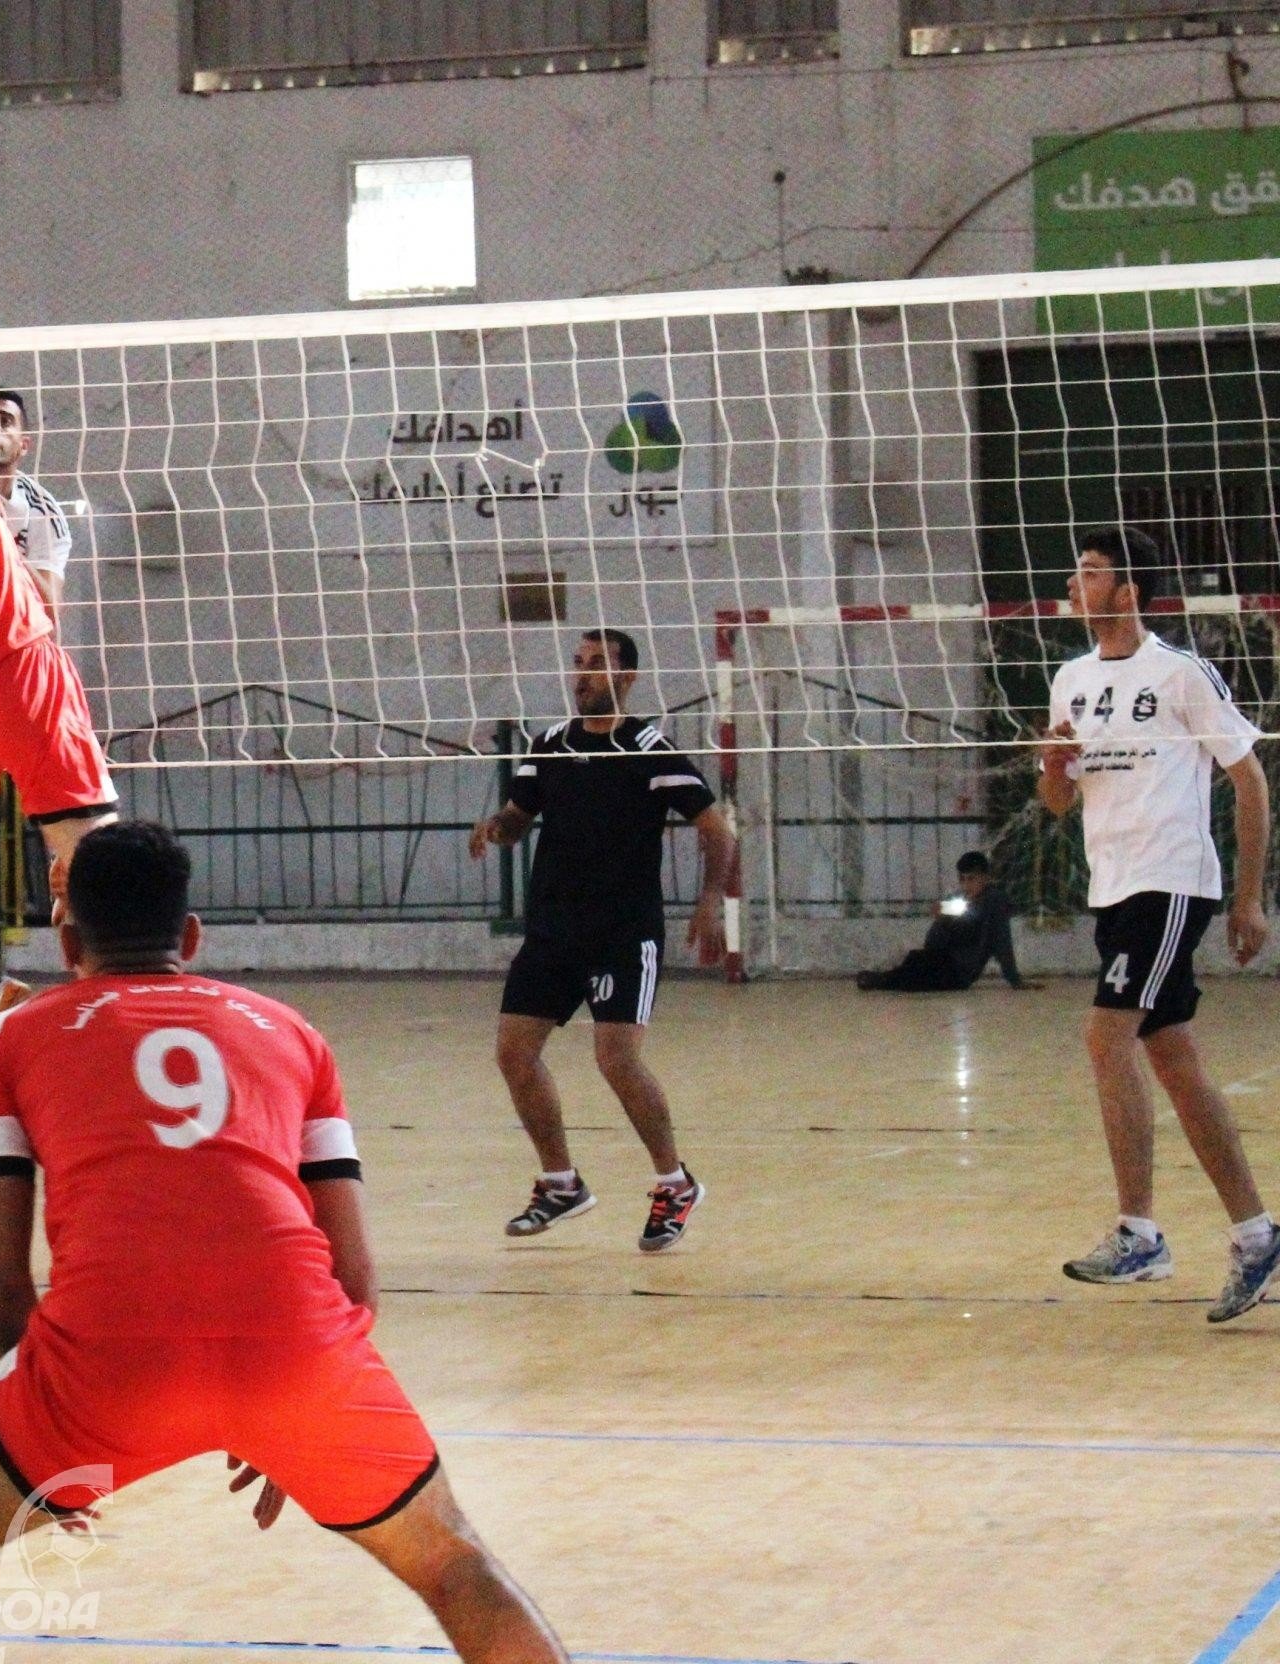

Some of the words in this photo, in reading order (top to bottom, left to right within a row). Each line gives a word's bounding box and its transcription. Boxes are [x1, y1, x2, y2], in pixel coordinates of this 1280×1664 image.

[1053, 172, 1196, 211] هدفك
[1210, 171, 1280, 215] قق
[387, 398, 523, 444] أهدافك
[475, 471, 563, 518] تصنع
[608, 485, 683, 517] جول
[1093, 686, 1115, 724] 4
[1104, 953, 1131, 994] 4
[133, 1027, 231, 1149] 9
